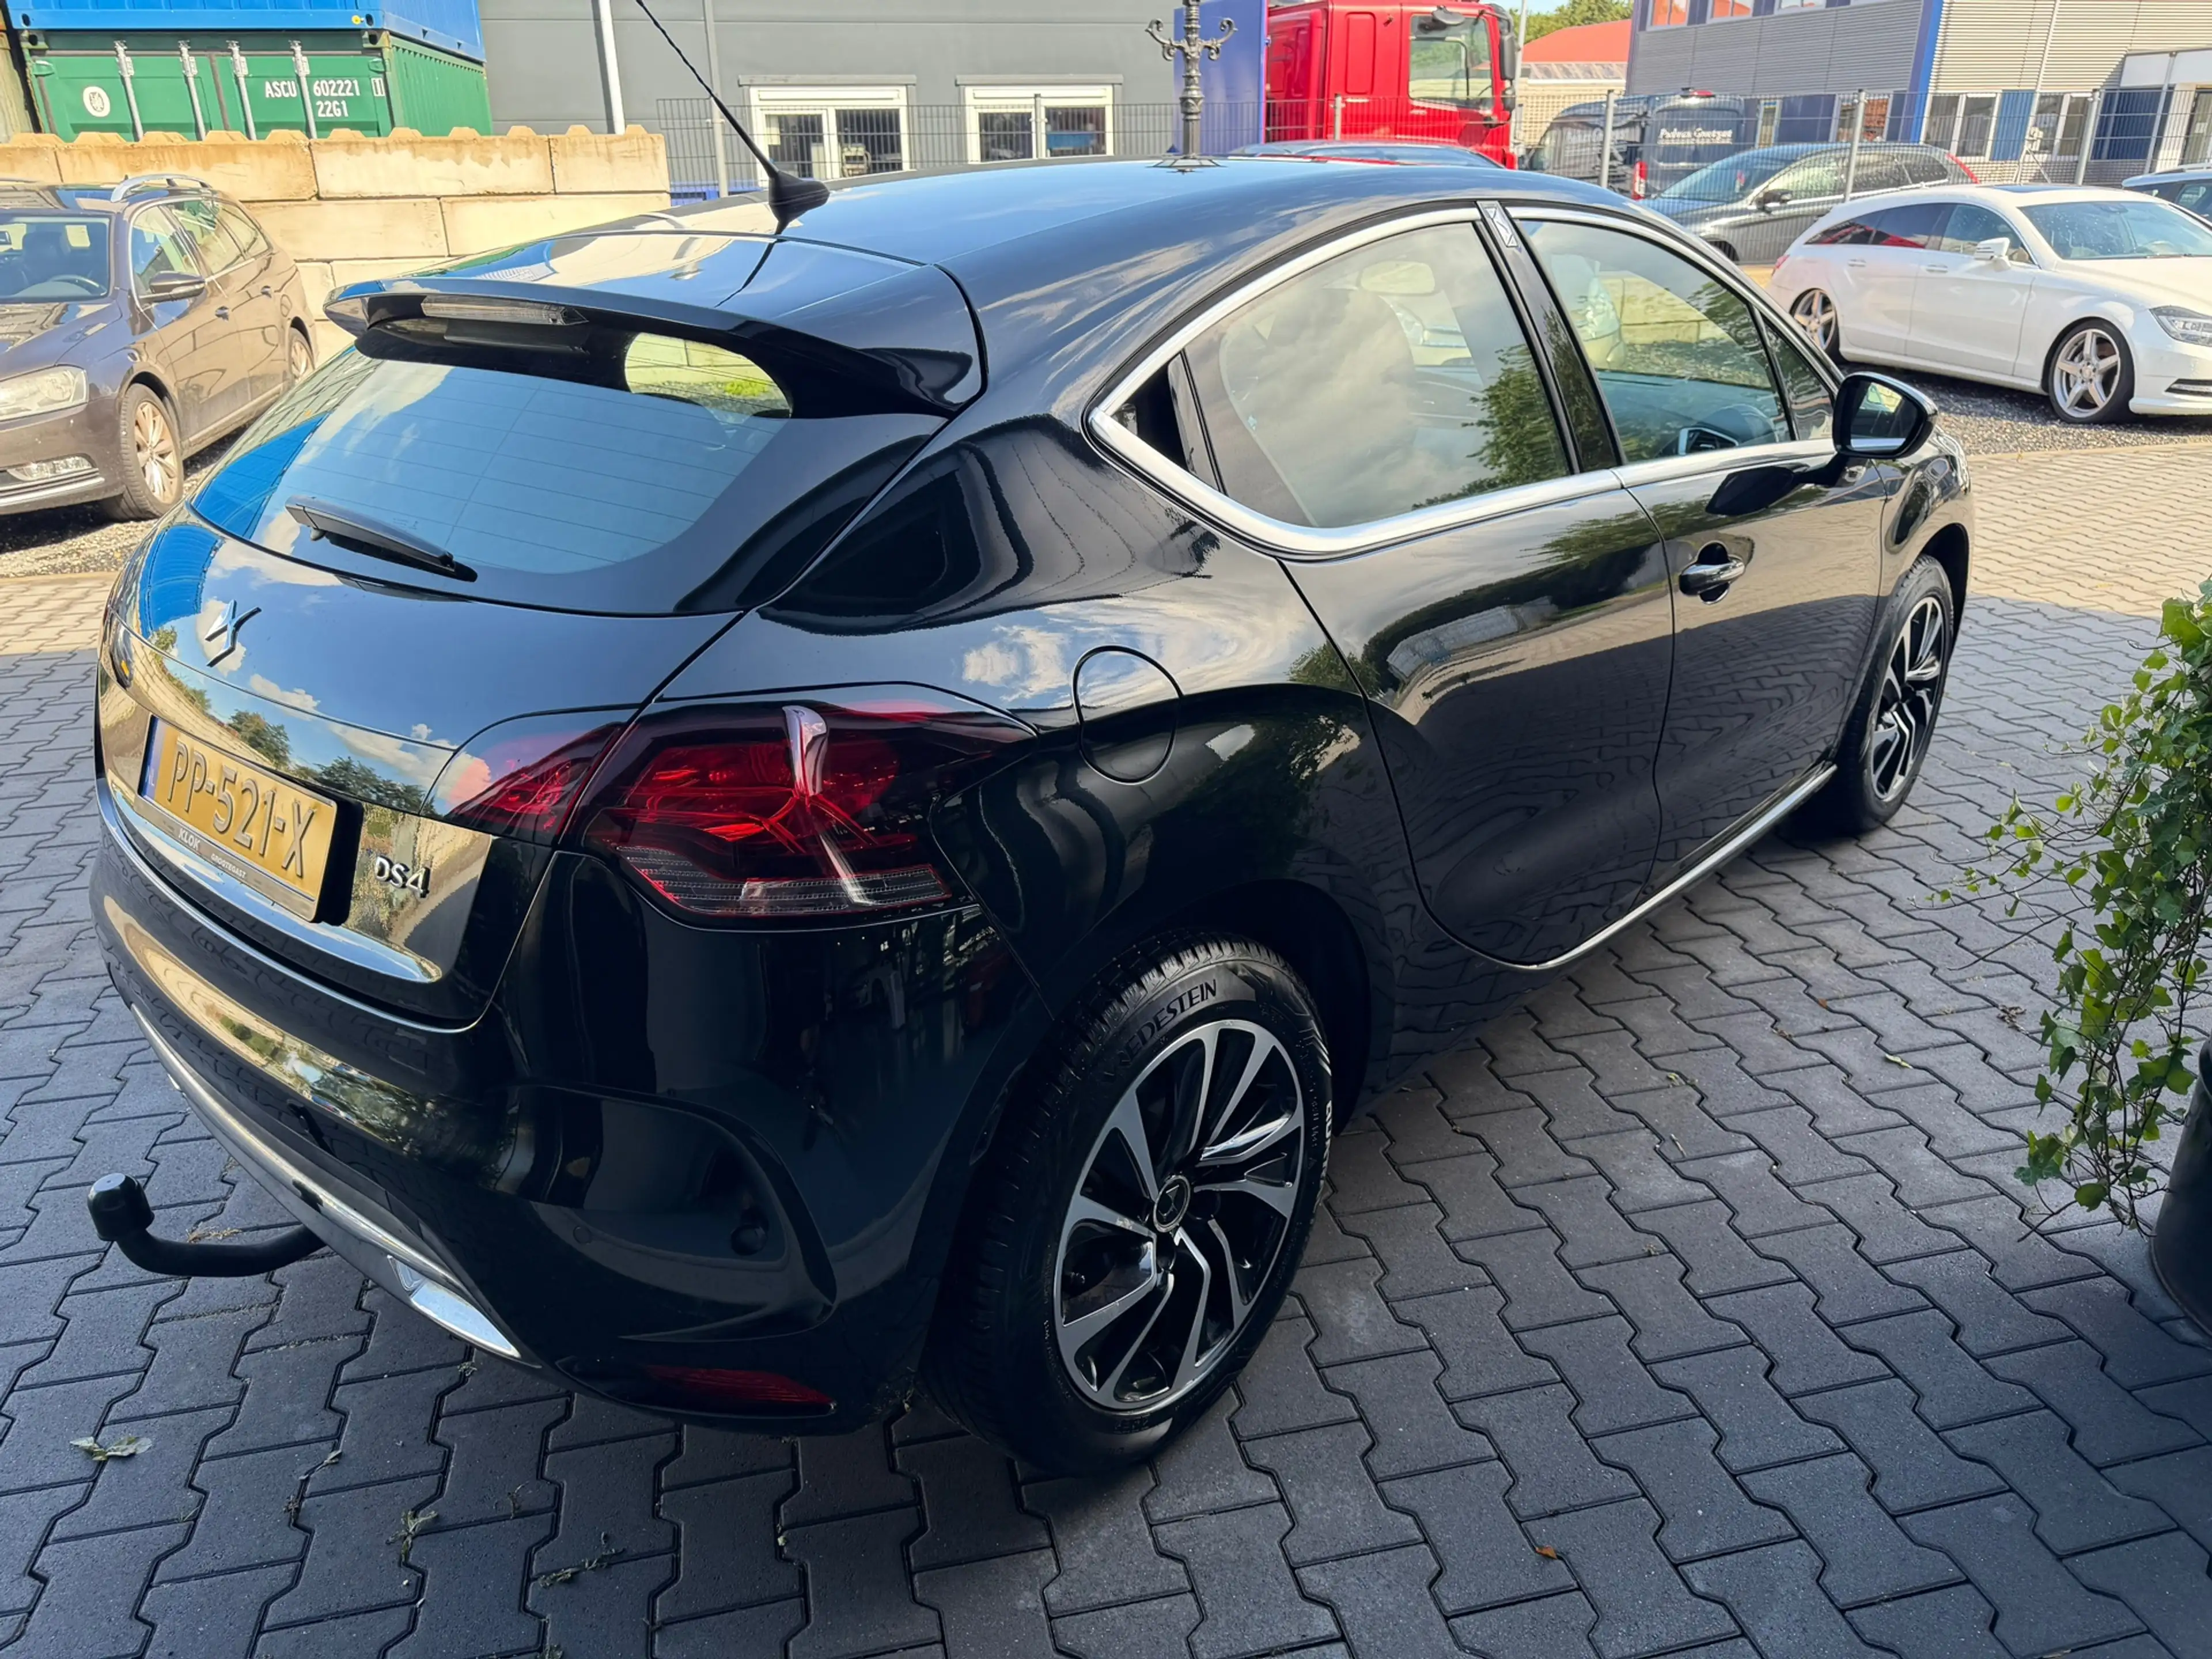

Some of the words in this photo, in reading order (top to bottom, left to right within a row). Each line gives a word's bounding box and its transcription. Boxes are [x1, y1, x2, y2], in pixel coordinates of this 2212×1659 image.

[265, 80, 297, 98] ASCU
[313, 79, 360, 96] 602221
[316, 100, 349, 117] 22G1
[168, 738, 317, 878] PP-521-X
[178, 828, 200, 851] KLOK
[374, 855, 431, 899] DS4
[1116, 979, 1217, 1067] EDESTEIN
